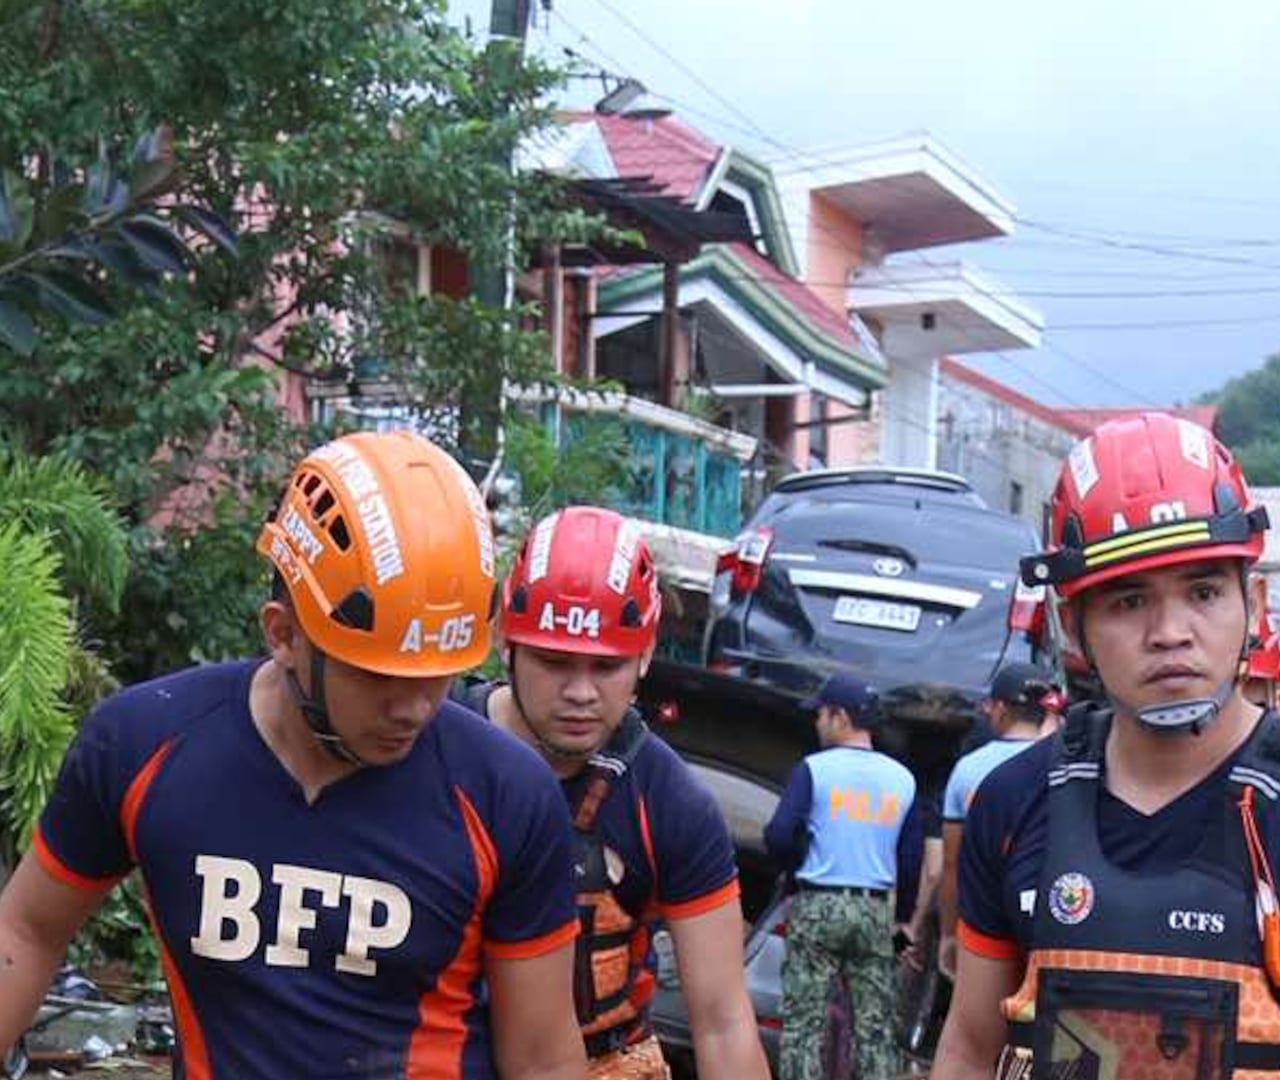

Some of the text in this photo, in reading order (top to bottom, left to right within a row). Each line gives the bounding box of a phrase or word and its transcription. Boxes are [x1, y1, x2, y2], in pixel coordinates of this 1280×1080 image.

[357, 494, 404, 584] STATION
[400, 613, 476, 652] A-05
[538, 601, 601, 638] A-04
[190, 853, 414, 977] BFP
[1168, 909, 1226, 933] CCFS
